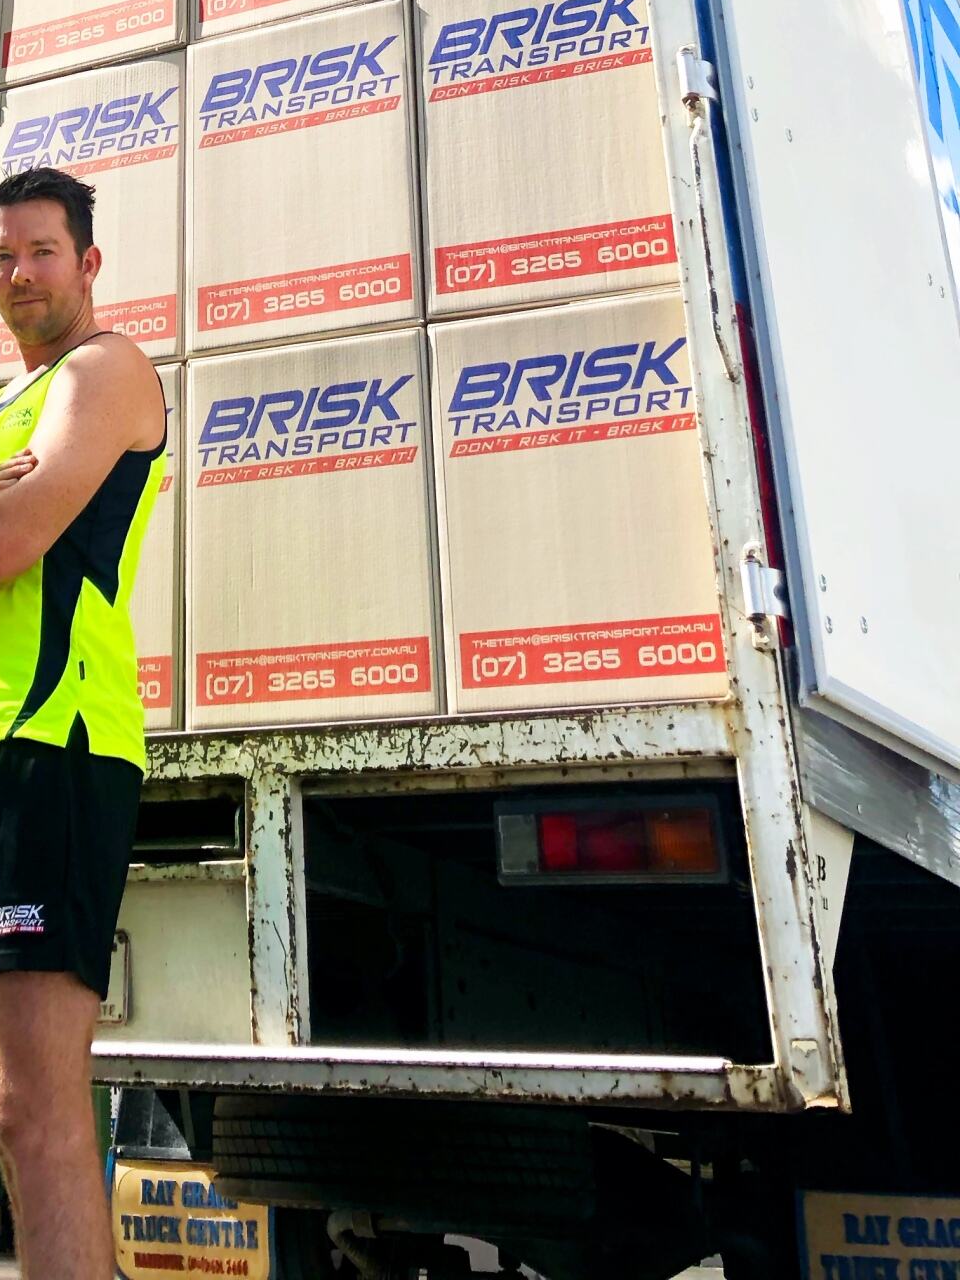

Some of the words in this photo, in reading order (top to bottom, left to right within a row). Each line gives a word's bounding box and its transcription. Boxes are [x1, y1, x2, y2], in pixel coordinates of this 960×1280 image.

[200, 35, 398, 113] BRISK
[428, 25, 650, 84] TRANSPORT
[2, 86, 179, 158] BRISK
[199, 75, 399, 131] TRANSPORT
[444, 258, 496, 289] (07)
[510, 250, 582, 276] 3265
[596, 238, 667, 264] 6000
[206, 297, 250, 326] (07)
[262, 288, 326, 314] 3265
[338, 276, 402, 302] 6000
[448, 336, 687, 413] BRISK
[198, 374, 415, 445] BRISK
[447, 386, 693, 436] TRANSPORT
[197, 422, 416, 467] TRANSPORT
[454, 437, 513, 455] DON'T
[518, 431, 562, 447] RISK
[568, 429, 587, 441] IT
[606, 420, 666, 437] BRISK
[201, 469, 253, 484] DON'T
[257, 463, 296, 478] RISK
[300, 461, 318, 473] IT
[333, 453, 387, 469] BRISK
[390, 450, 413, 462] IT!
[205, 670, 254, 700] (07)
[267, 669, 336, 692] 3265
[350, 663, 419, 687] 6000
[471, 651, 528, 683] (07)
[542, 648, 622, 673] 3265
[637, 641, 717, 667] 6000
[141, 1178, 177, 1206] RAY
[181, 1180, 238, 1209] GRA
[120, 1214, 182, 1244] TRUCK
[185, 1218, 258, 1249] CENTRE
